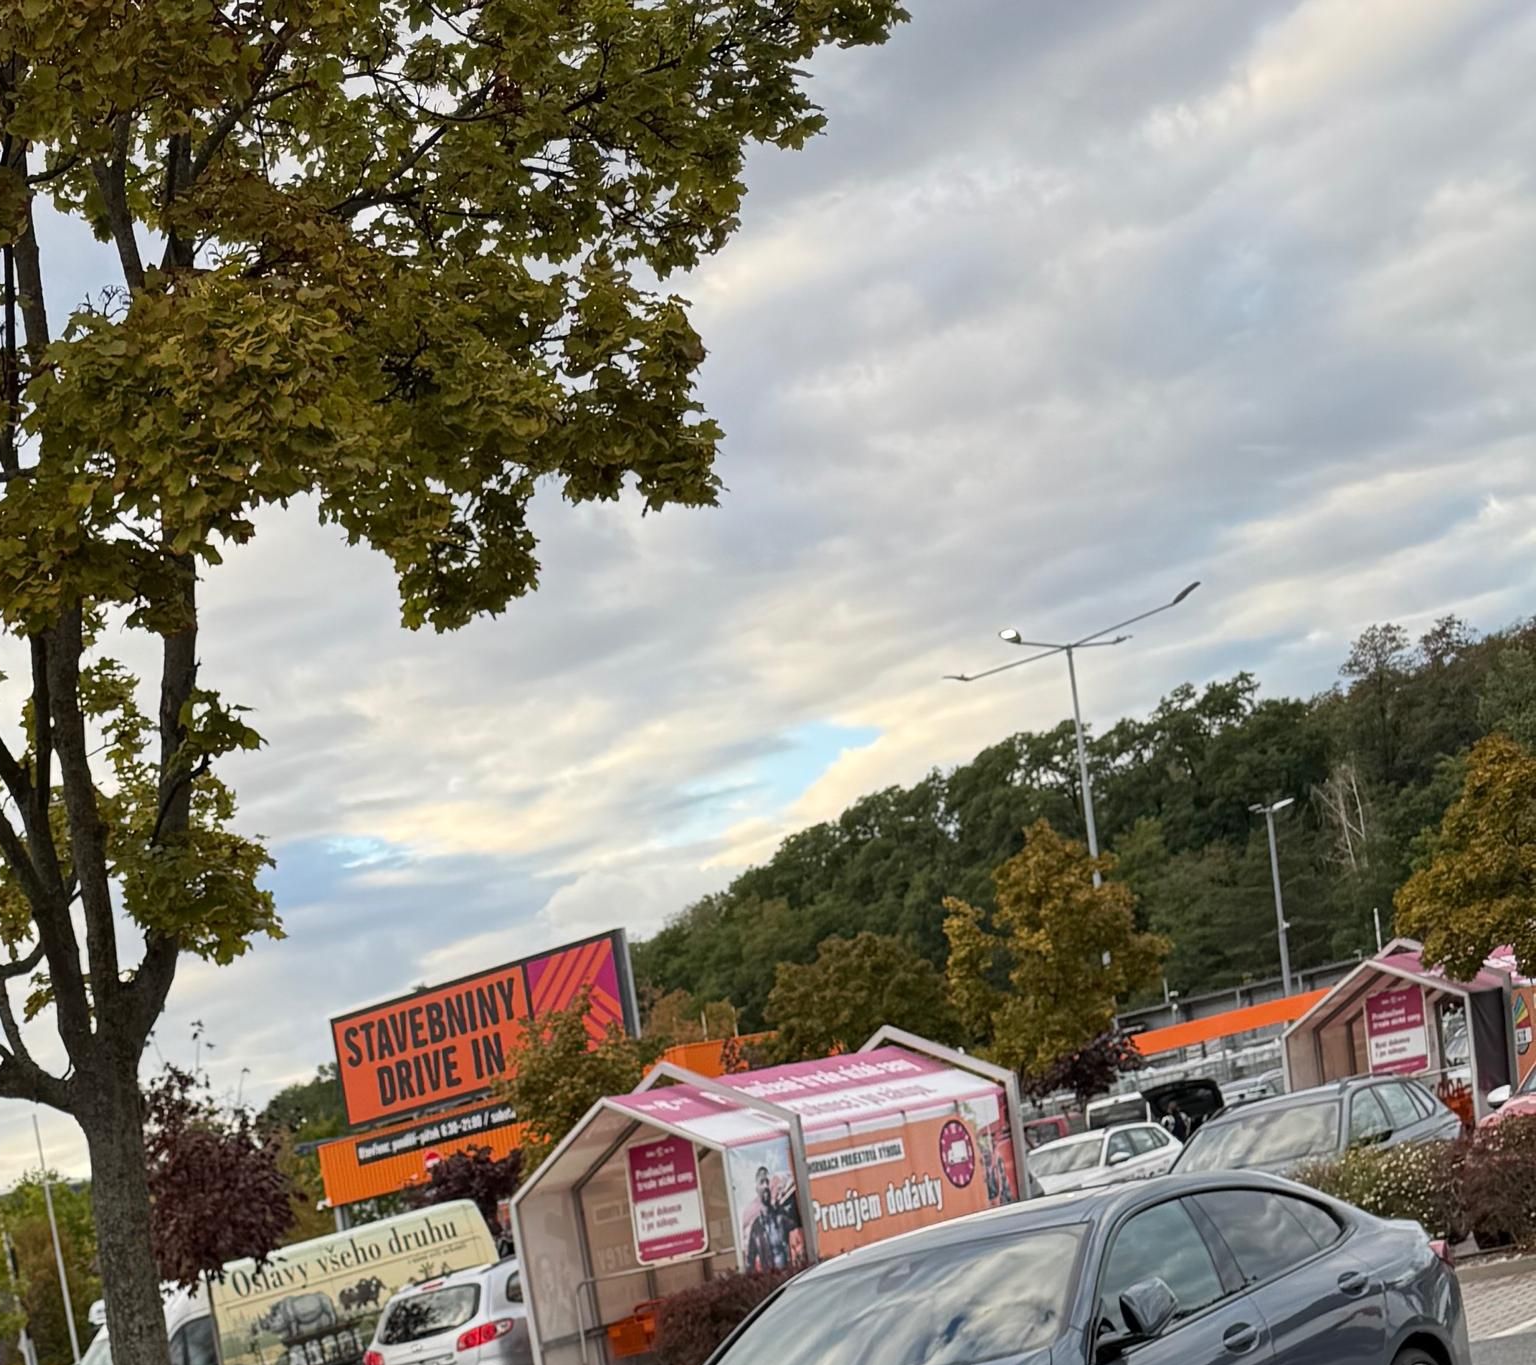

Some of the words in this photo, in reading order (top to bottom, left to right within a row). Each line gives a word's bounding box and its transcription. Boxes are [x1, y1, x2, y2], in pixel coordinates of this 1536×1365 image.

[344, 977, 514, 1068] STAVEBNINY
[376, 1045, 463, 1107] DRIVE
[470, 1032, 506, 1080] IN
[812, 1190, 882, 1232] Pronájem
[886, 1173, 943, 1215] dodávky
[231, 1259, 309, 1299] Oslavy
[317, 1237, 382, 1273] všeho
[388, 1217, 458, 1256] druhu
